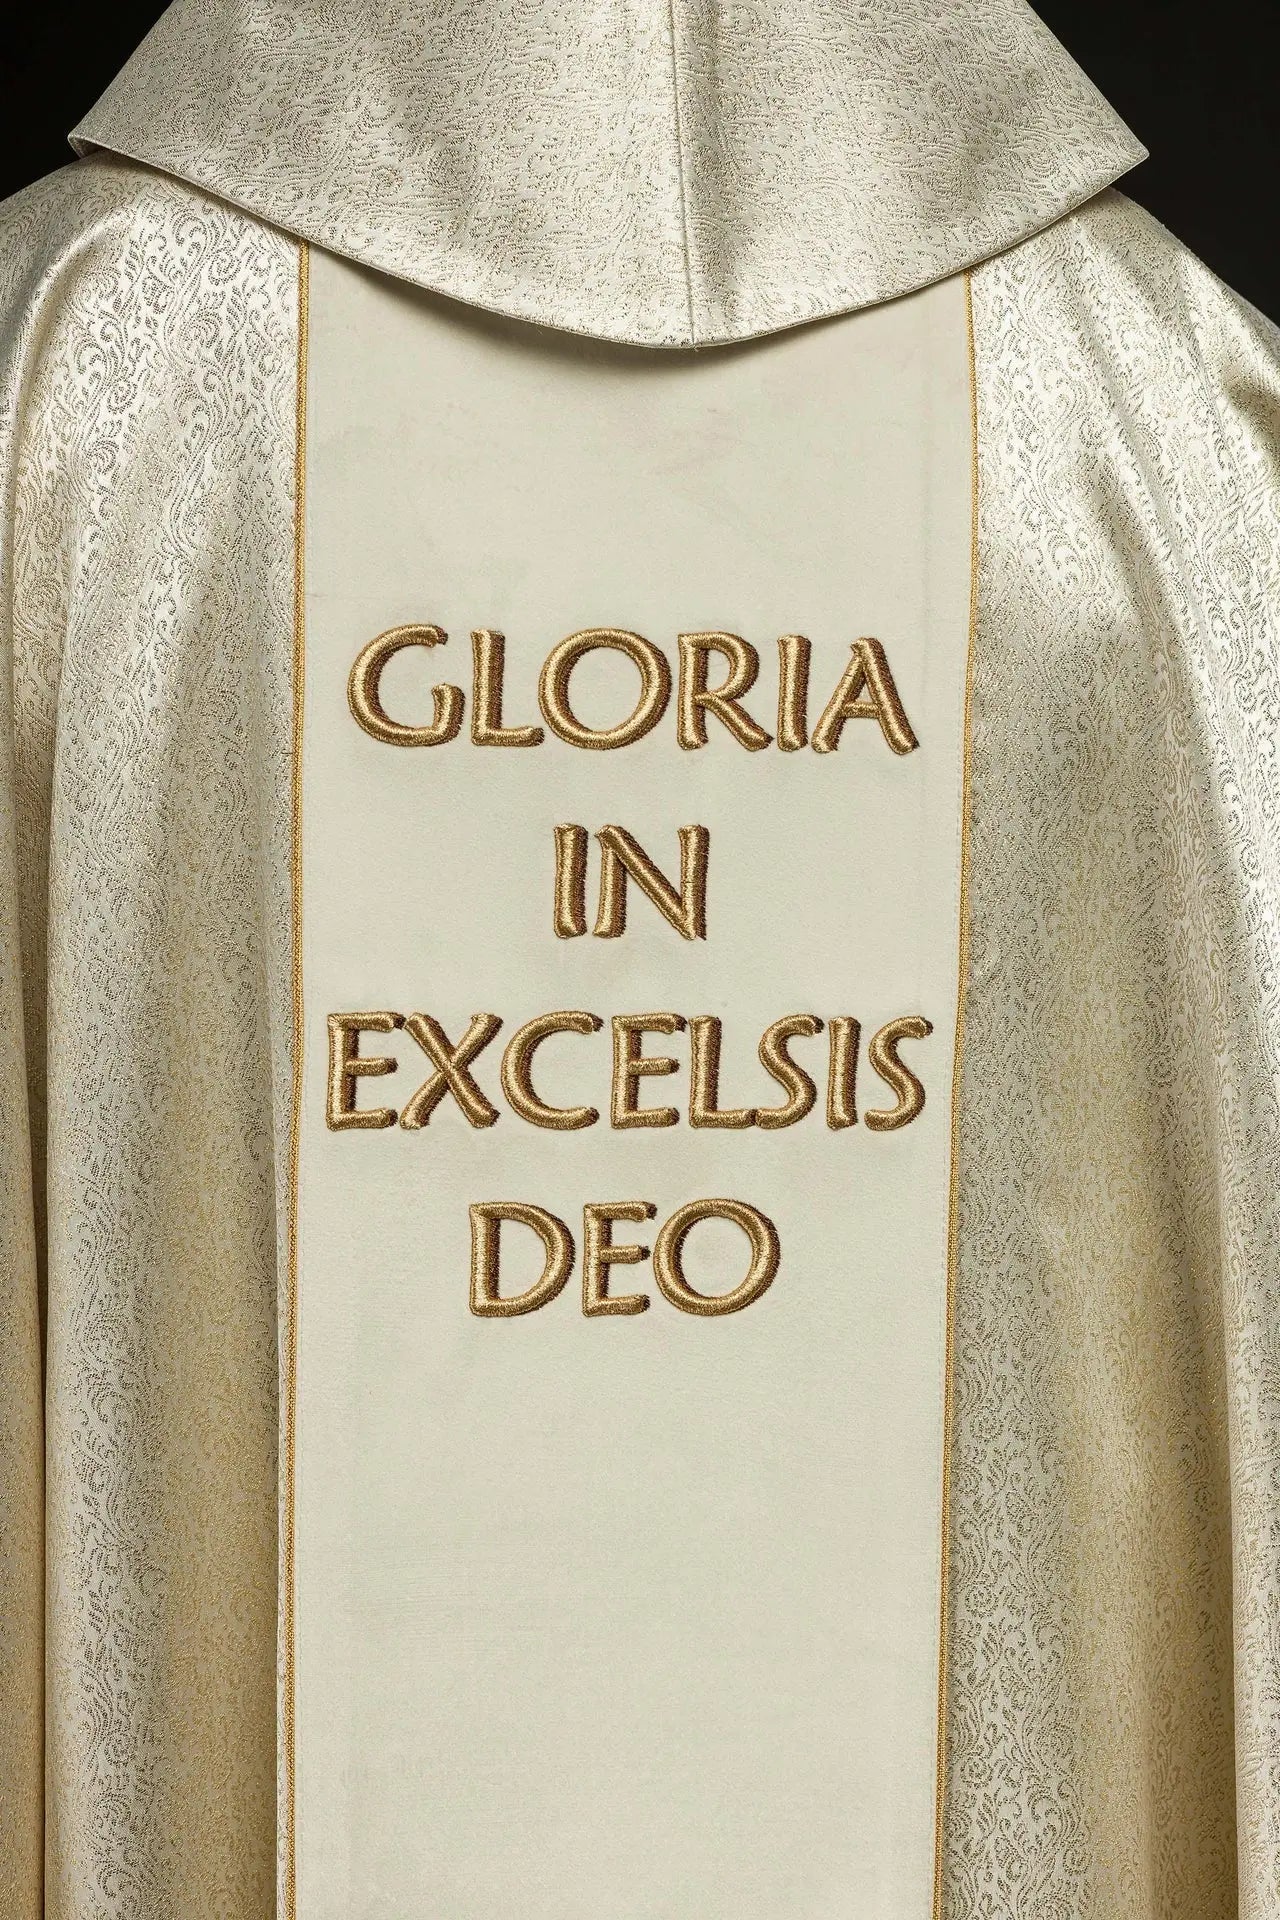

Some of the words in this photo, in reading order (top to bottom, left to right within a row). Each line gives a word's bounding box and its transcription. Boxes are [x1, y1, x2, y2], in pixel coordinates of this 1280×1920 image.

[347, 623, 919, 755] GLORIA
[553, 823, 710, 941] IN
[325, 1011, 934, 1132] EXCELSIS
[469, 1198, 781, 1318] DEO
